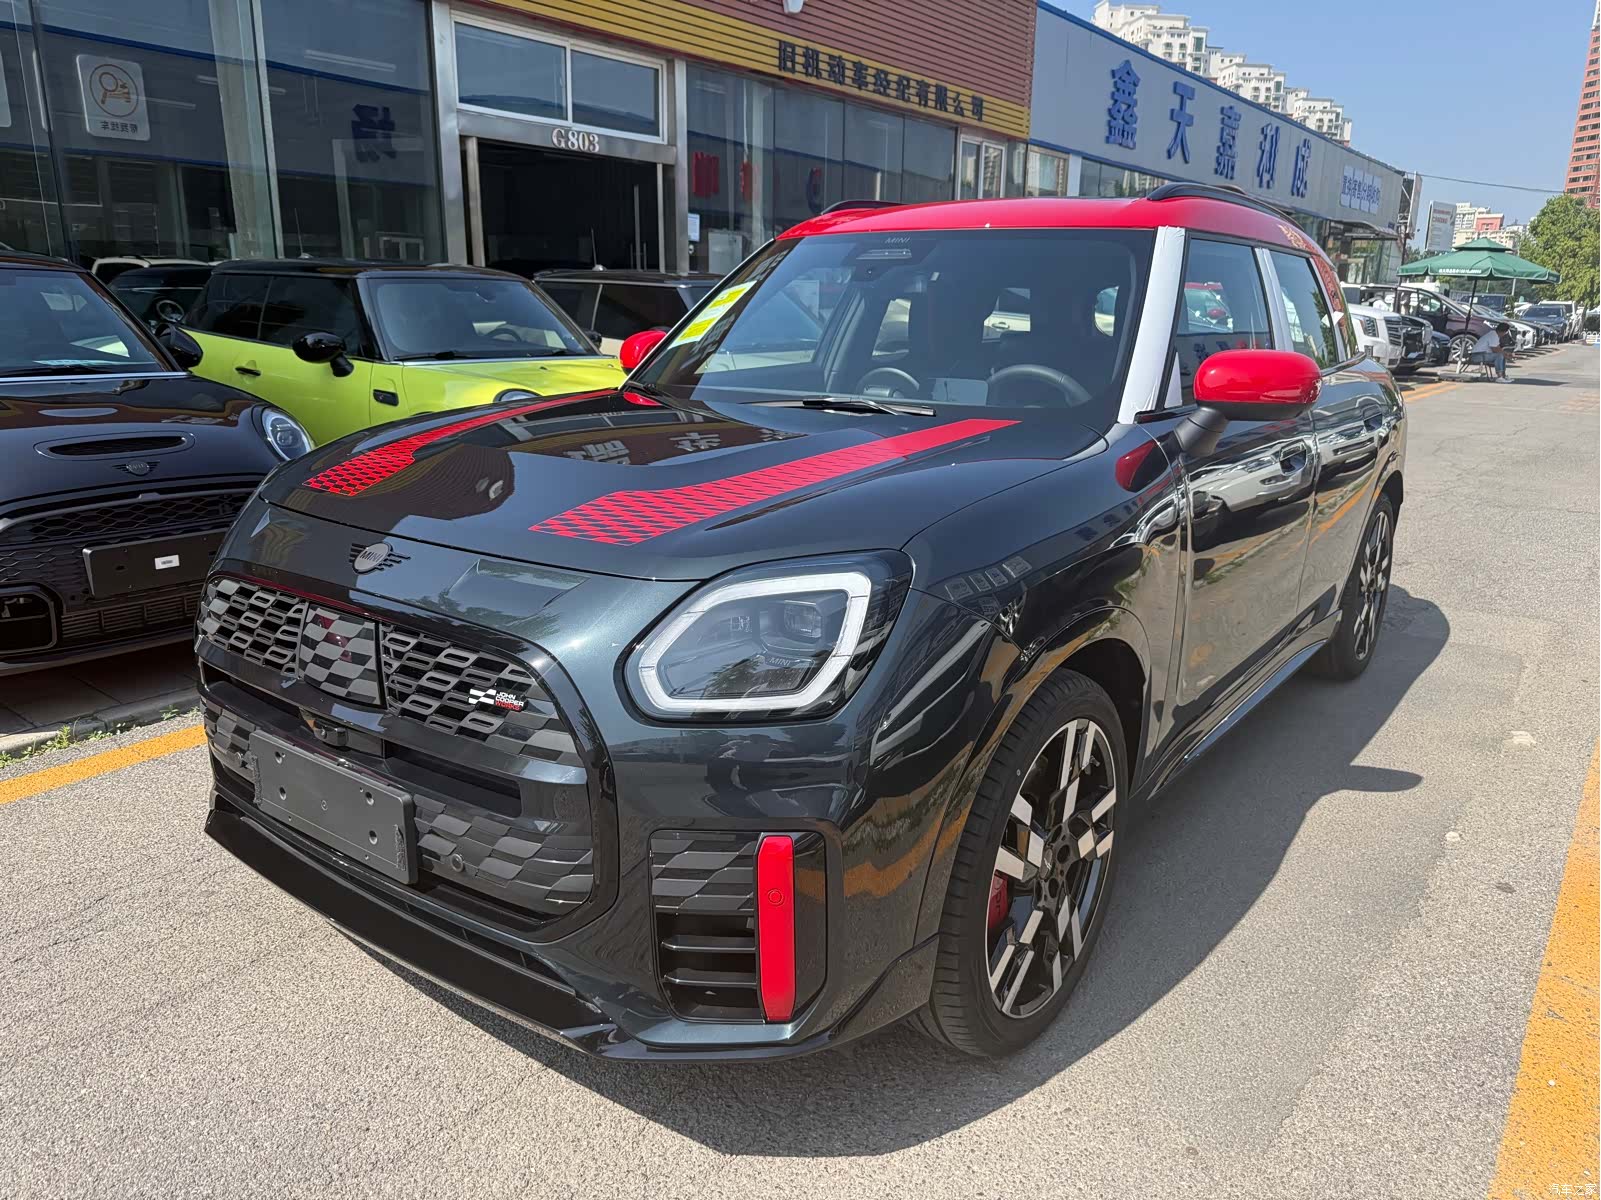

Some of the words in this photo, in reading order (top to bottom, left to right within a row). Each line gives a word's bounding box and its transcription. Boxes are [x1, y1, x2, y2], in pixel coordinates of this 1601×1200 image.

[778, 40, 984, 122] 旧机动车经纪有限公司
[1105, 59, 1312, 198] 鑫天嘉利成
[552, 128, 600, 153] G803
[884, 236, 911, 244] MINI
[769, 657, 791, 666] MINI
[496, 692, 517, 700] JOHN
[495, 696, 525, 707] COOPER
[495, 701, 521, 711] WORKS
